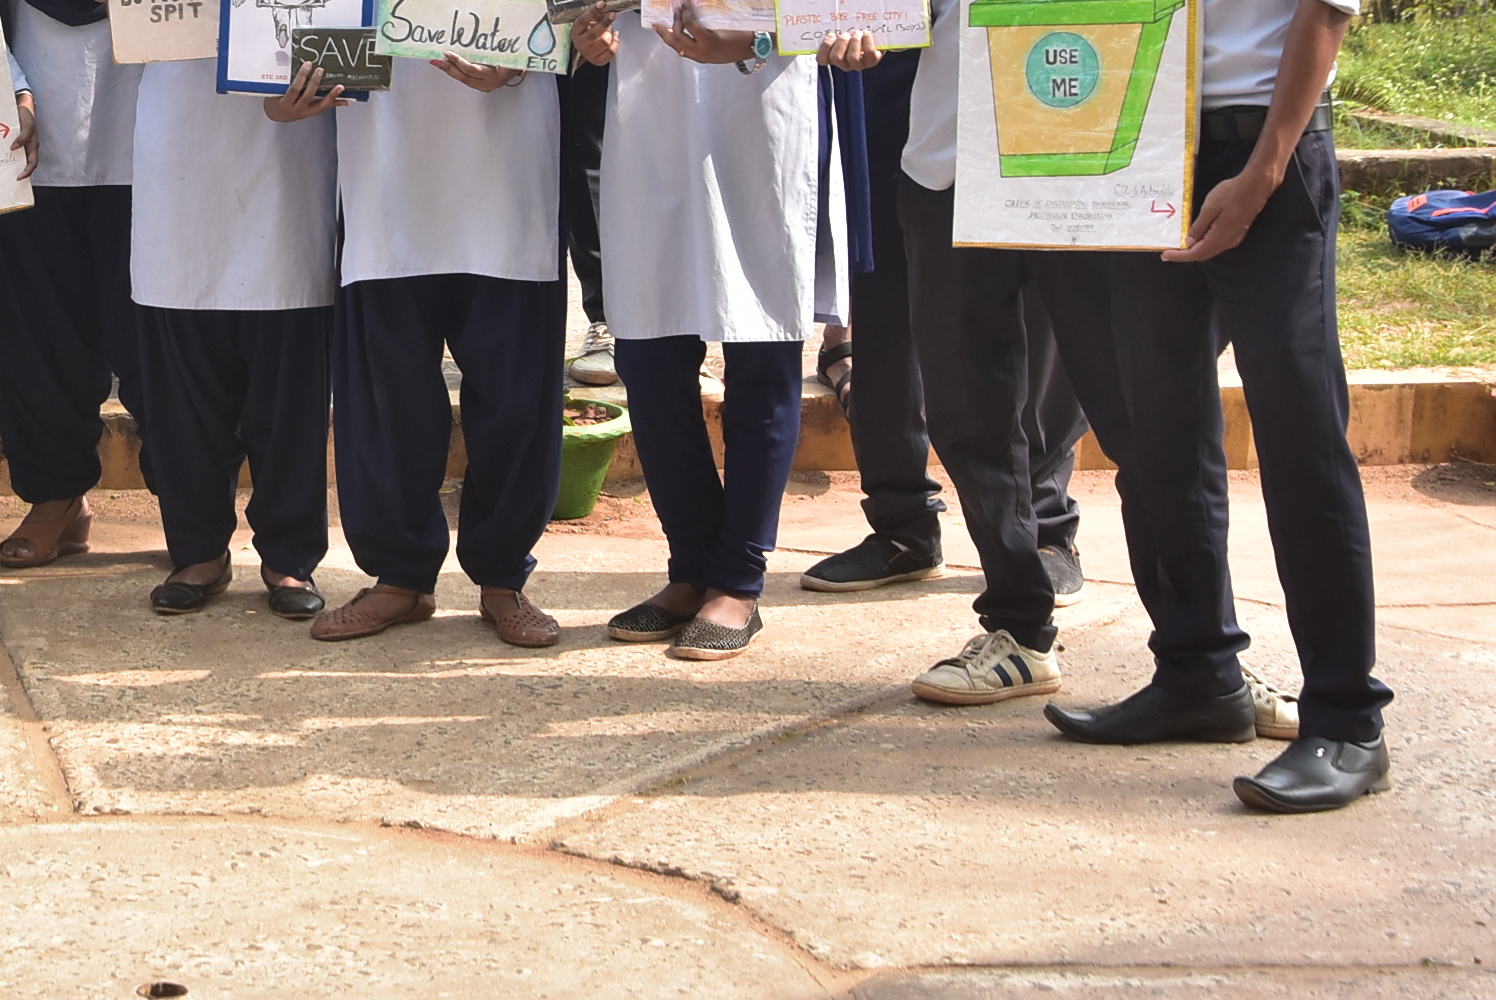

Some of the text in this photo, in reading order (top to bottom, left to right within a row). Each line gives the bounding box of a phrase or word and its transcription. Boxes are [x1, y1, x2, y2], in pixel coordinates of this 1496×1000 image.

[149, 2, 203, 23] SPIT
[784, 14, 822, 26] PLASTIC
[830, 12, 848, 21] BAG
[856, 12, 878, 21] FREE
[450, 9, 523, 54] Water
[300, 35, 382, 68] SAVE
[1044, 48, 1080, 66] USE
[526, 56, 558, 71] ETC
[1051, 77, 1080, 98] ME
